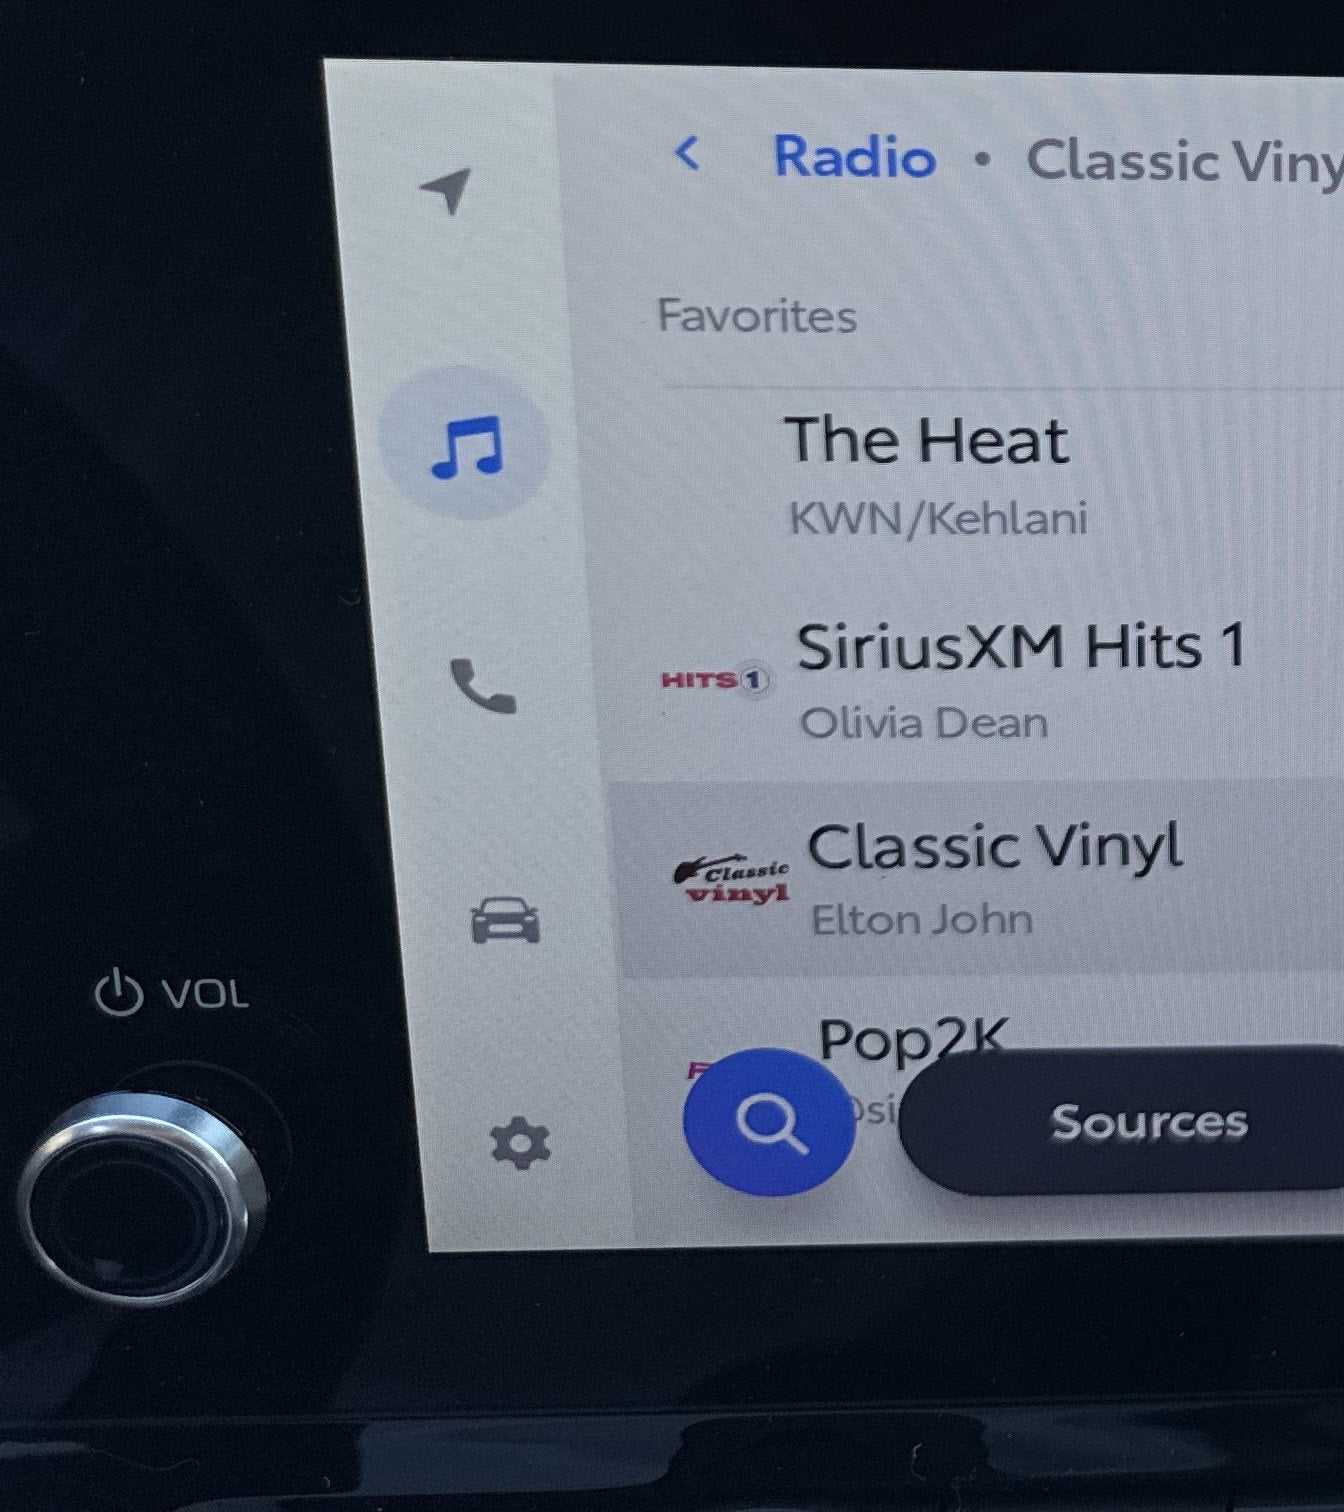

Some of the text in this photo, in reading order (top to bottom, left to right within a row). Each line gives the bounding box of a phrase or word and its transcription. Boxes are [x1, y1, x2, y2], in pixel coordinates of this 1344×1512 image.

[774, 133, 937, 179] Radio
[1027, 136, 1220, 182] Classic
[657, 296, 858, 334] Favorites
[783, 413, 1070, 466] The Heat
[789, 499, 1088, 543] KWN/Kehlani
[798, 620, 1243, 672] SiriusXM Hits 1
[661, 671, 739, 689] HITS
[799, 704, 1049, 741] Olivia Dean
[808, 820, 1184, 879] Classic Vinyl
[704, 860, 791, 883] Classic
[685, 883, 789, 906] vinyl
[812, 901, 1034, 937] Elton John
[161, 978, 250, 1009] VOL
[820, 1016, 1010, 1071] Pop2K
[1051, 1102, 1250, 1141] Sources
